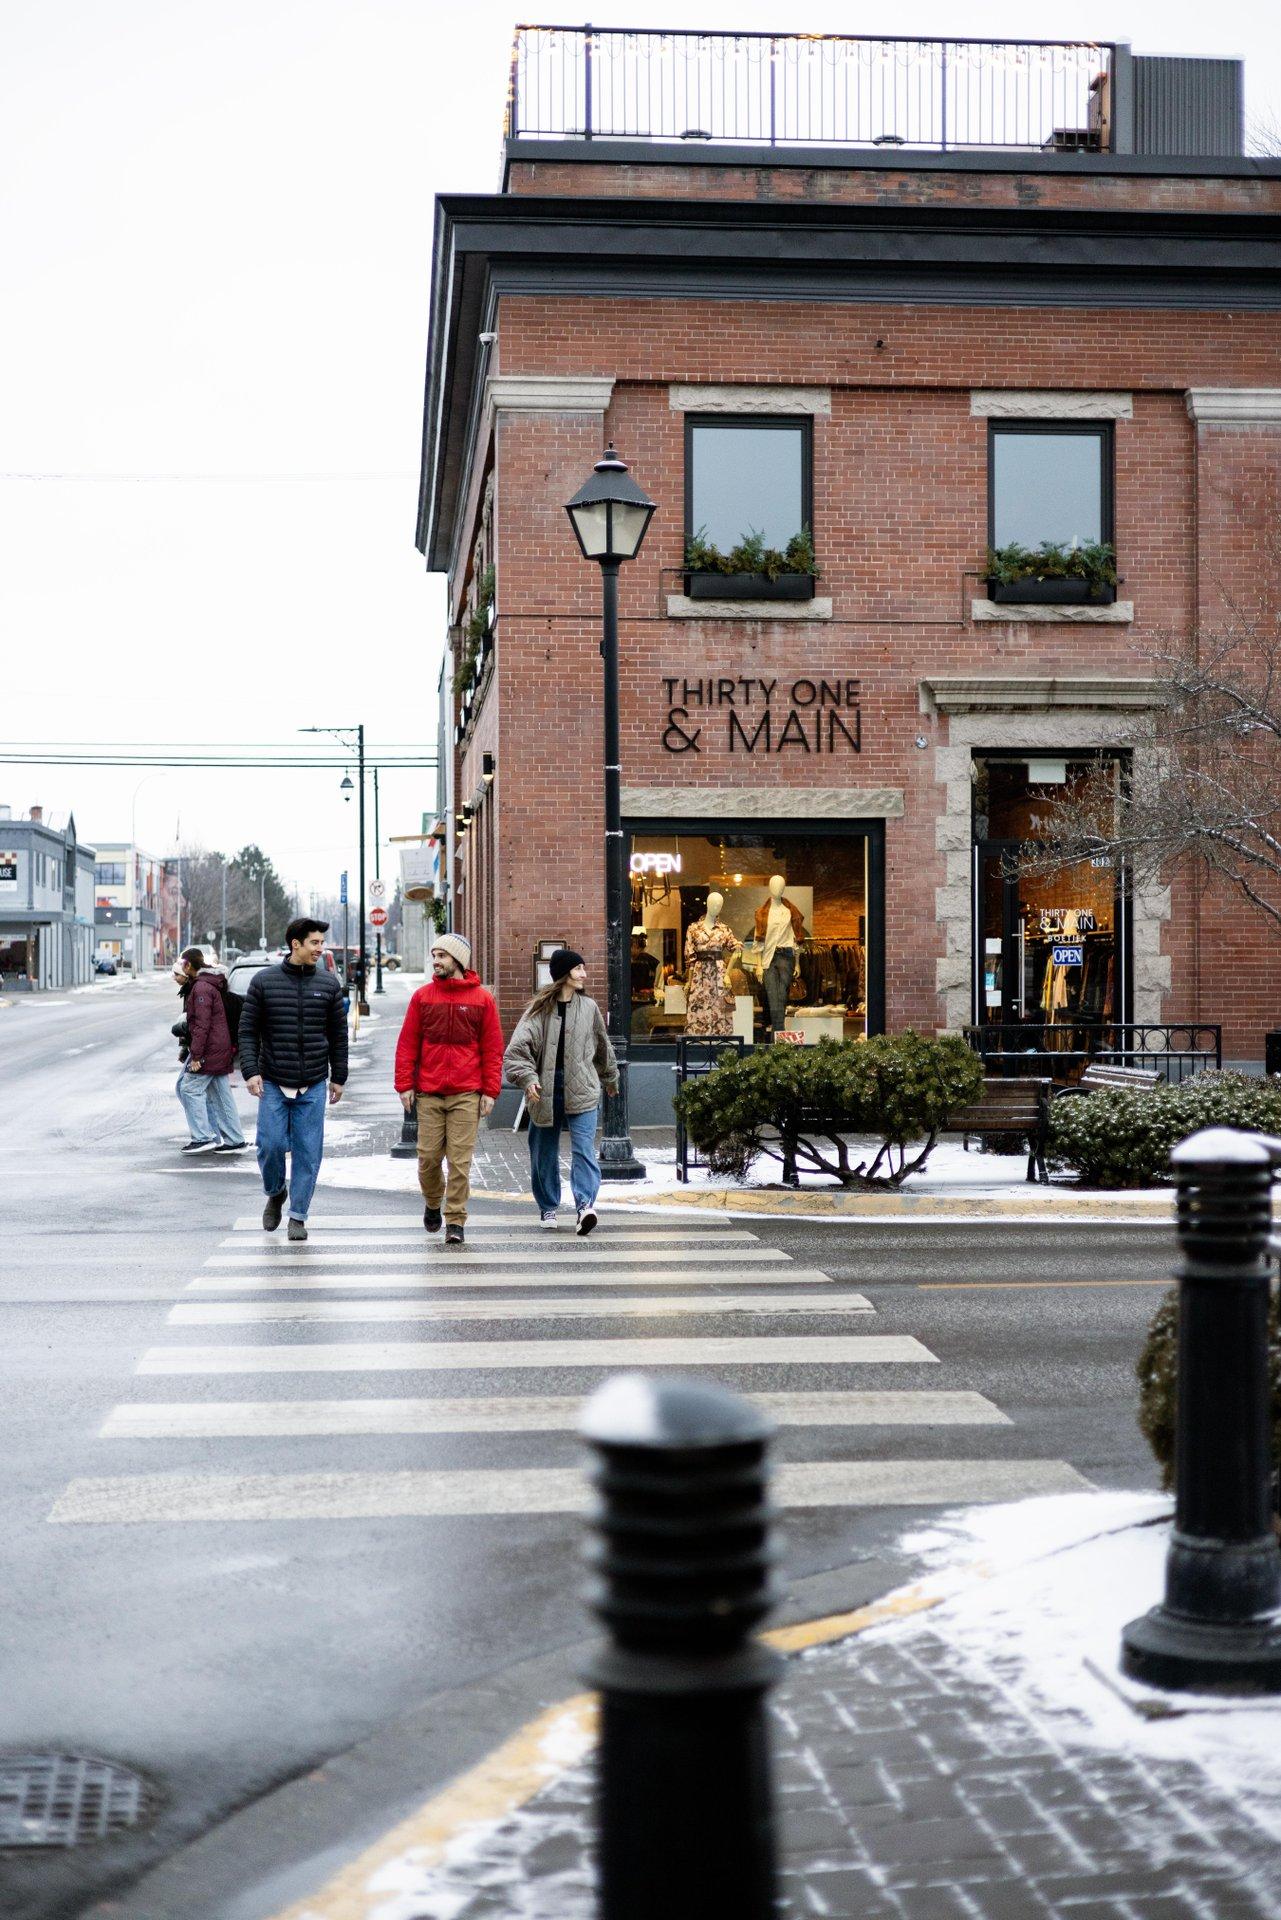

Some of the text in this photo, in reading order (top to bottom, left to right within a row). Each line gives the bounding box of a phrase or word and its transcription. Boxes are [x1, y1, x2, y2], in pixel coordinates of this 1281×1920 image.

[662, 678, 861, 706] THIRTY ONE
[662, 707, 861, 754] & MAIN
[630, 853, 681, 873] OPEN
[370, 912, 387, 921] STOP
[1074, 908, 1093, 917] ONE
[1040, 916, 1094, 930] & MAIN
[1054, 949, 1082, 963] OPEN
